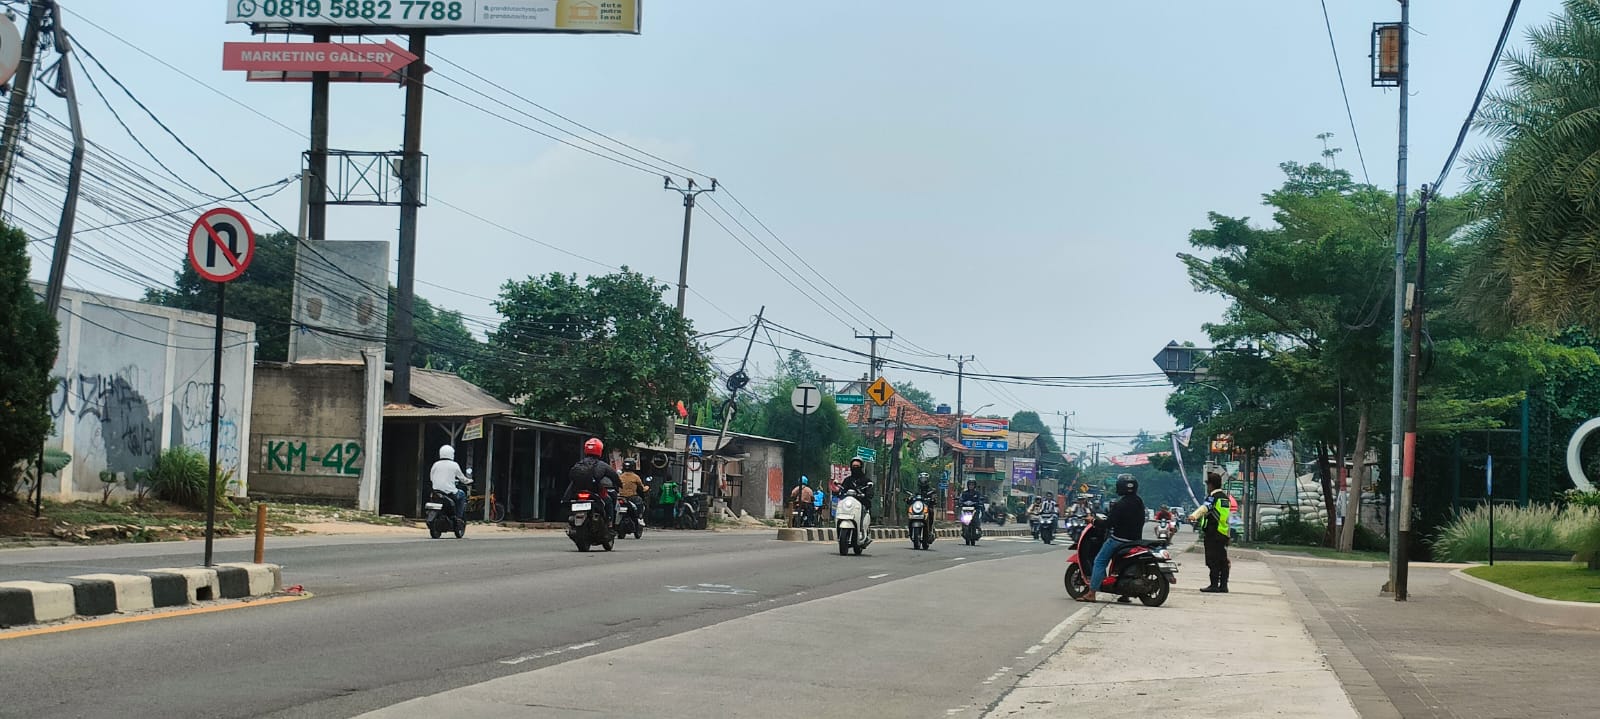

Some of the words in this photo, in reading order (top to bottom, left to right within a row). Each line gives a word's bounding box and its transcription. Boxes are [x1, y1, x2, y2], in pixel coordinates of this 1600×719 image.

[263, 0, 321, 18] 0819
[329, 0, 391, 20] 5882
[399, 1, 462, 21] 7788
[240, 50, 325, 62] MARKETING
[329, 51, 395, 63] GALLERY
[267, 440, 362, 475] KM-42
